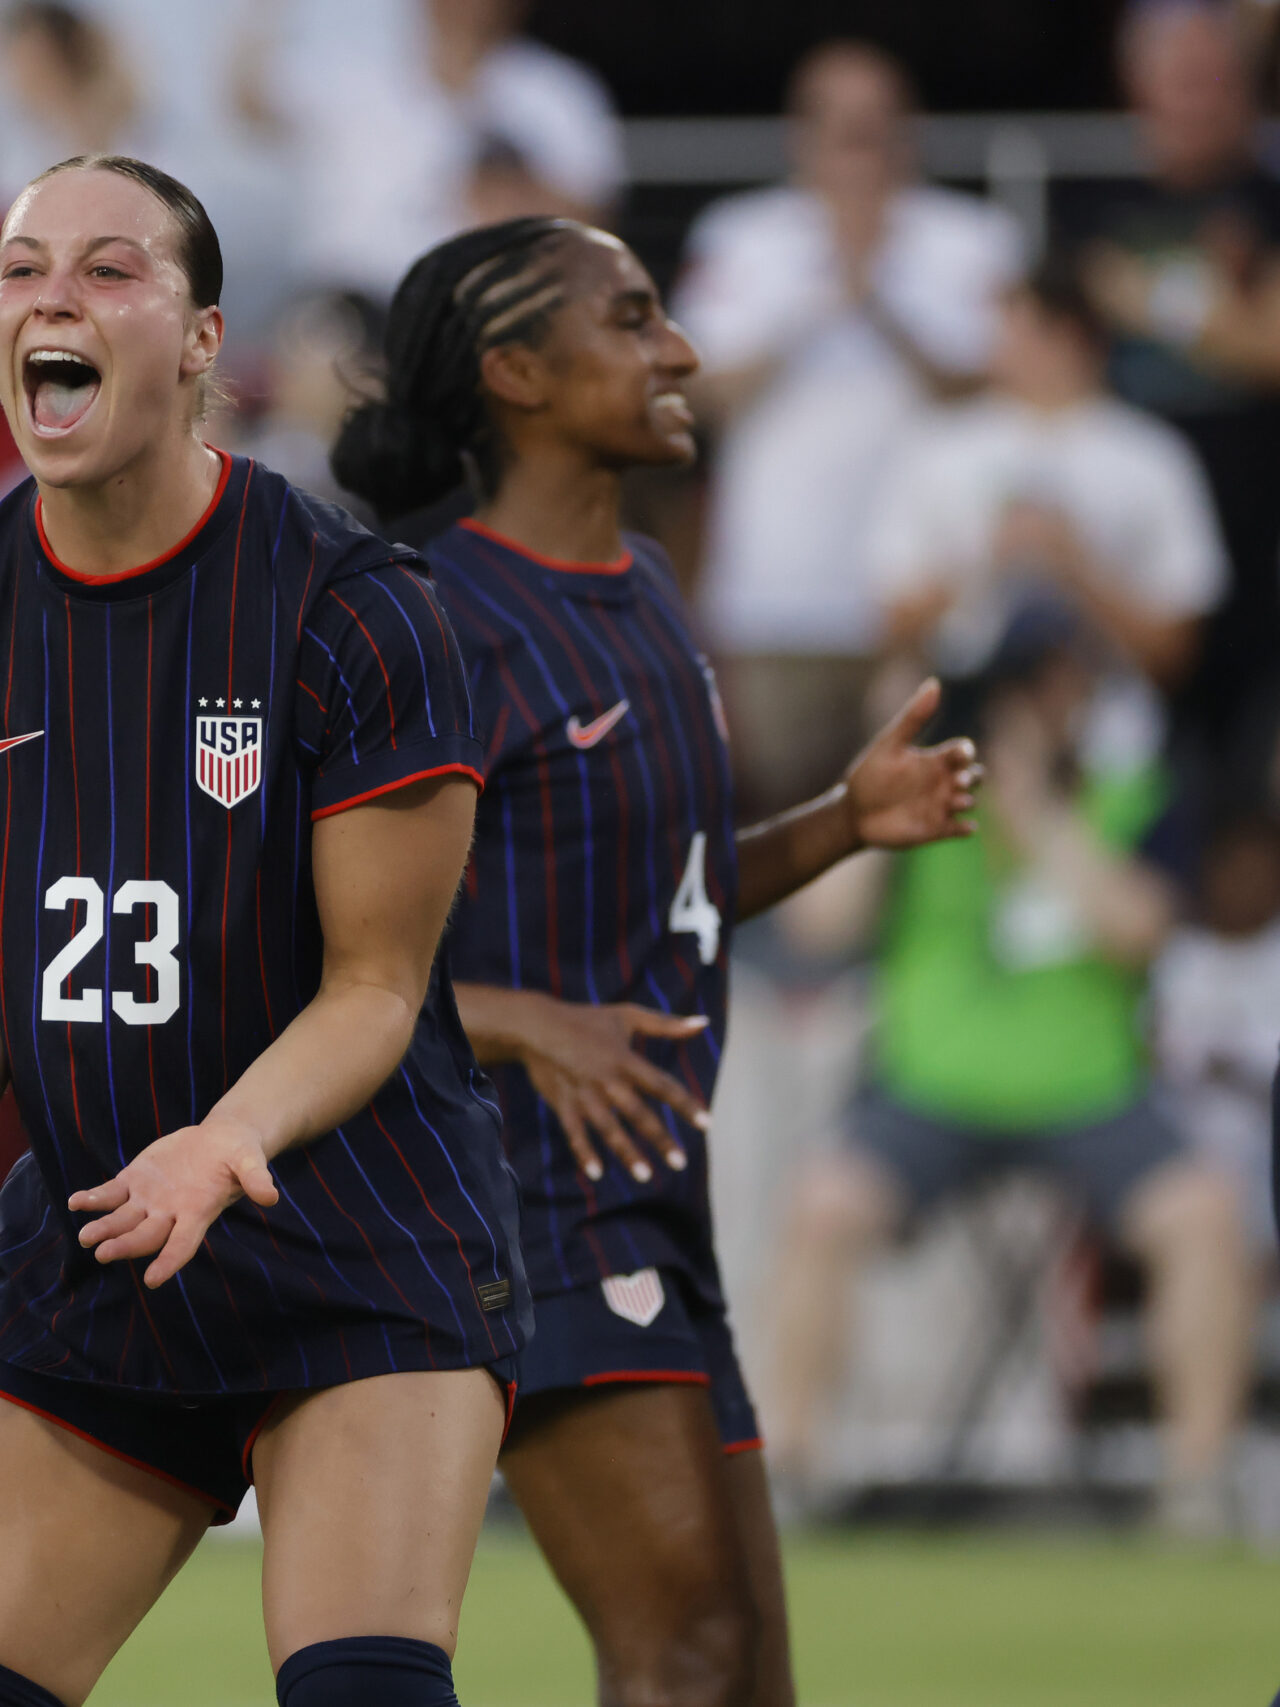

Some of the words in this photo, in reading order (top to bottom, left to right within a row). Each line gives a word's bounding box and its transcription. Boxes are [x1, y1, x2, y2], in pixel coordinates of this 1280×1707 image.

[200, 721, 258, 756] USA
[41, 876, 180, 1025] 23
[669, 830, 722, 966] 4
